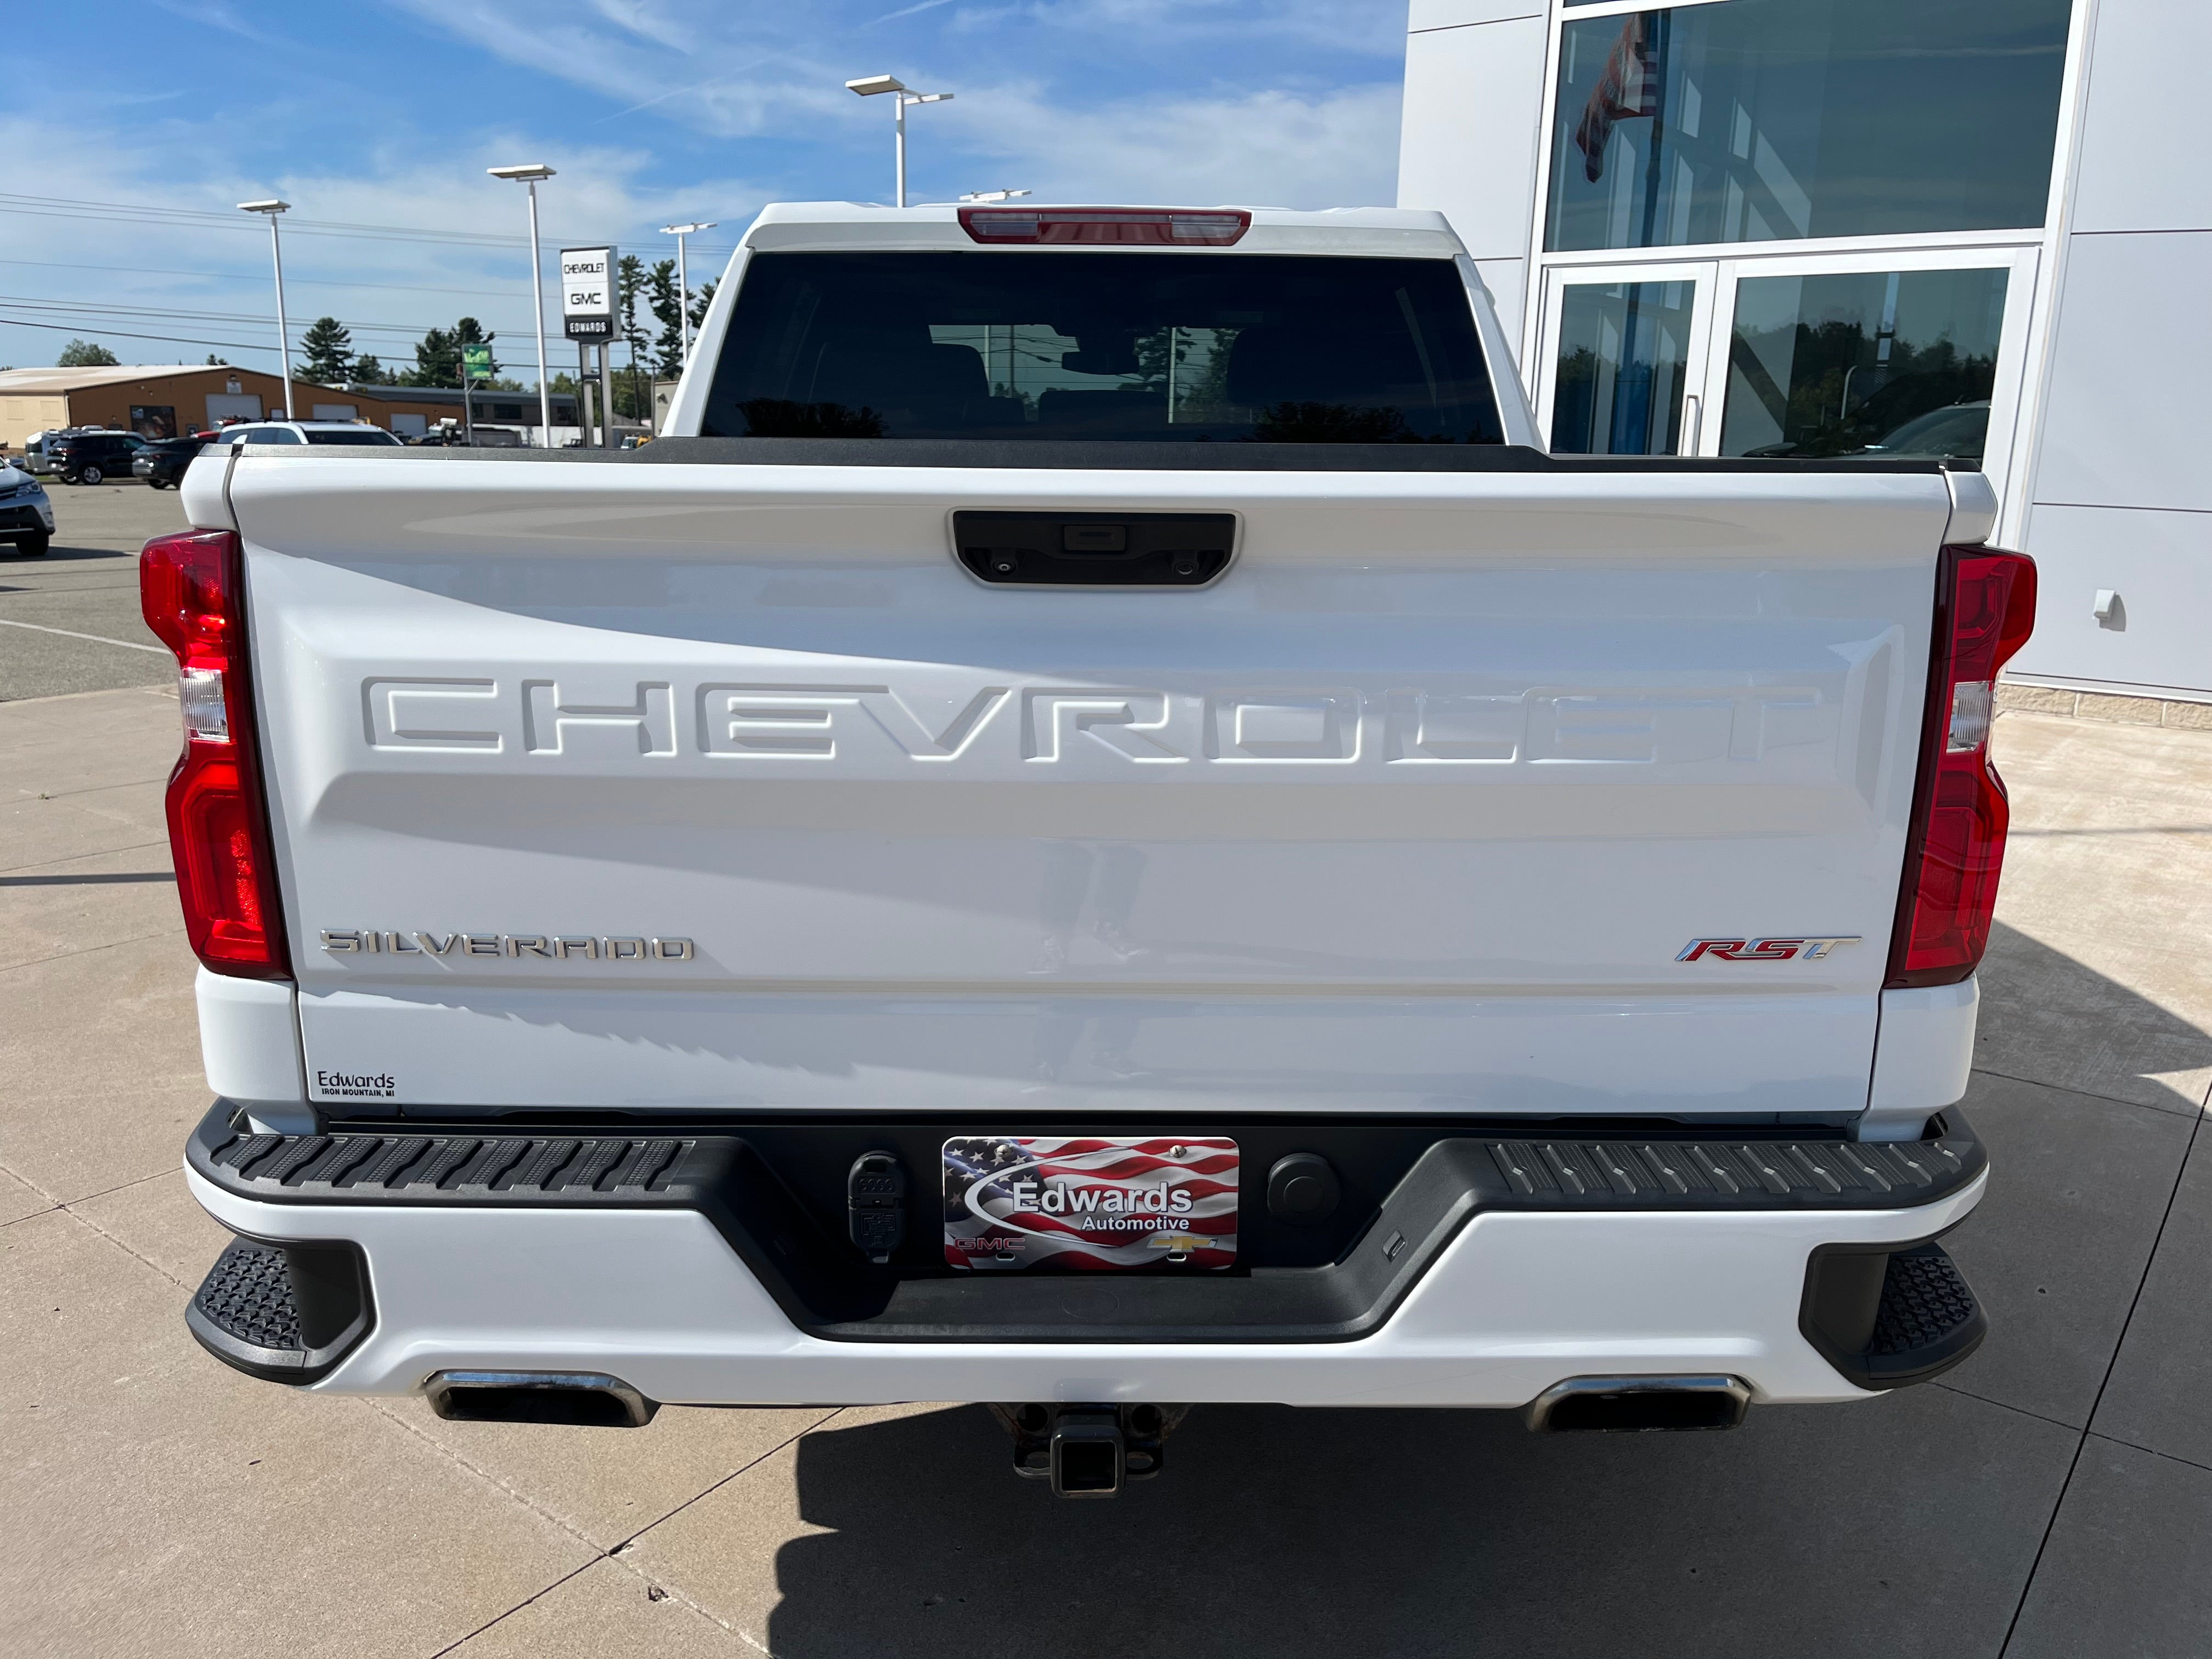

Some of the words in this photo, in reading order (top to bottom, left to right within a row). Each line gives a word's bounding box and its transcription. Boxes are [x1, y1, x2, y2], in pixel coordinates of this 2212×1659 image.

[564, 263, 604, 274] CHEVROLET
[571, 292, 601, 305] GMC
[569, 321, 606, 333] EDWARDS
[360, 675, 1824, 765] CHEVROLET
[320, 929, 695, 961] SILVERADO
[1674, 936, 1863, 961] RST
[317, 1070, 395, 1088] Edwards
[342, 1088, 384, 1097] MOUNTAIN,
[1012, 1181, 1193, 1213] Edwards
[1081, 1216, 1190, 1231] Automotive
[953, 1238, 1026, 1251] GMC
